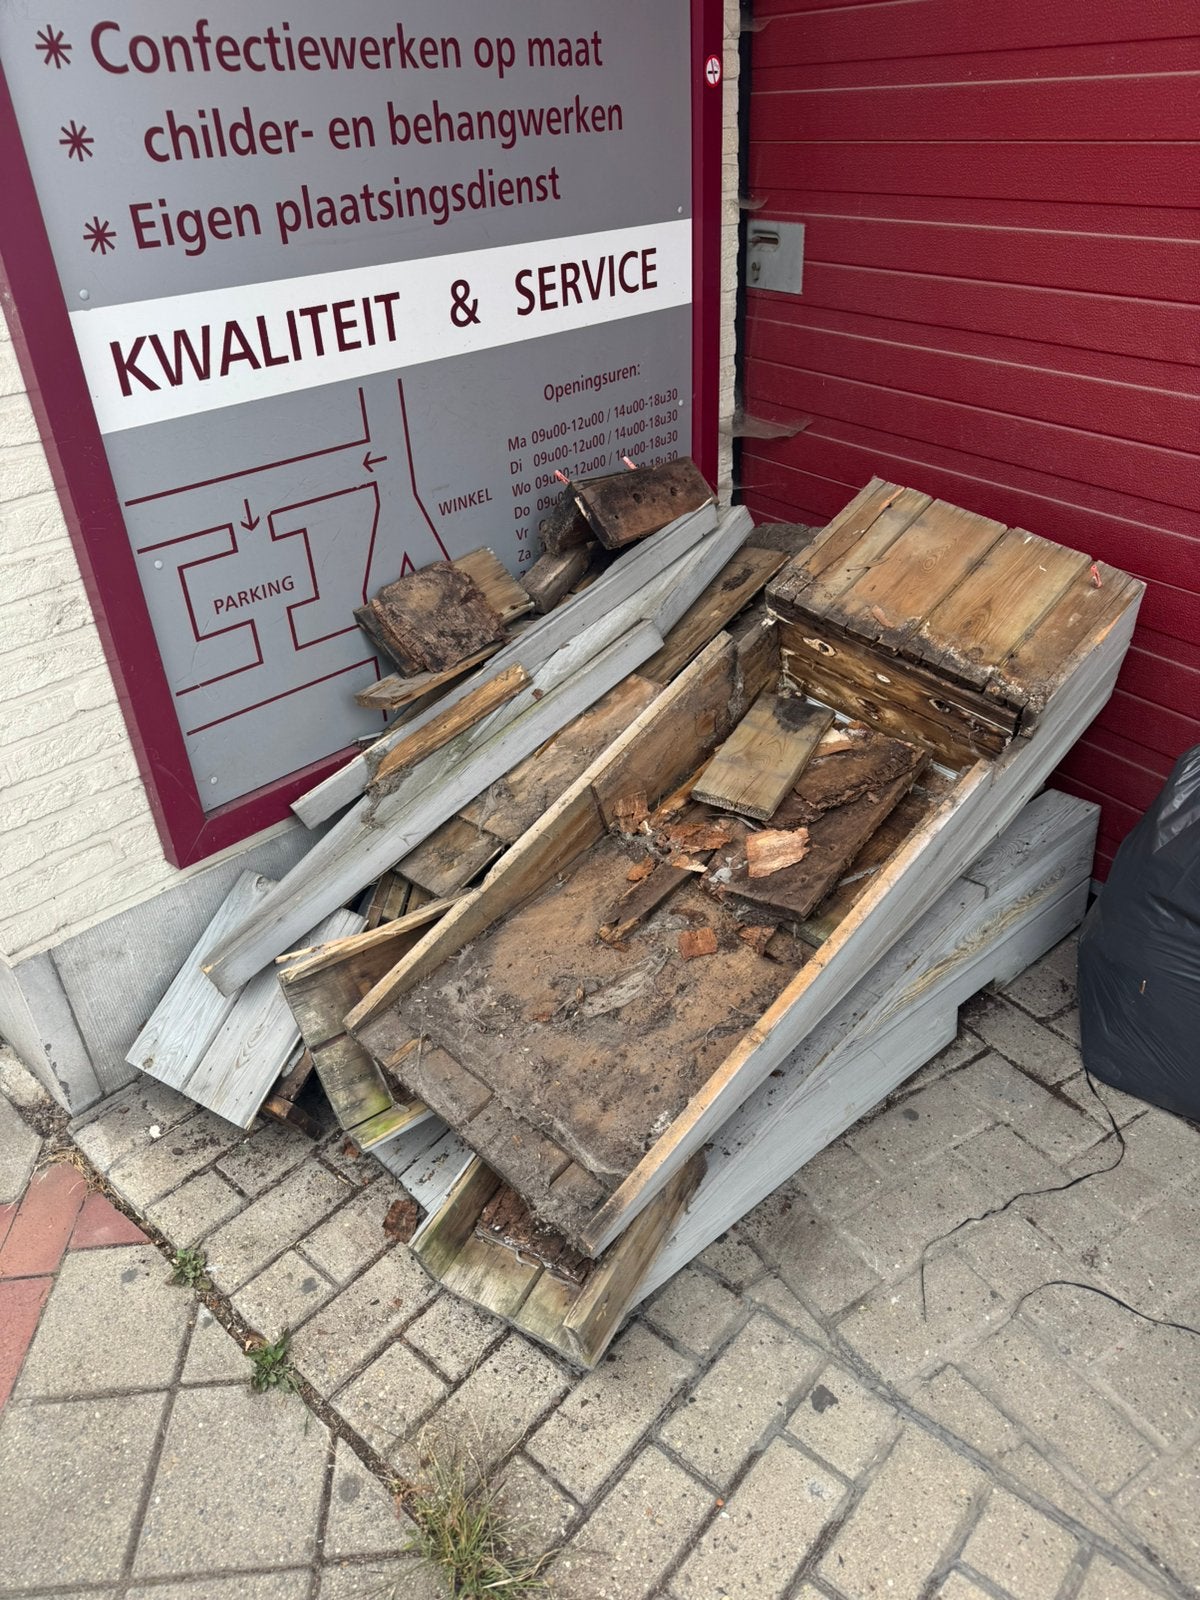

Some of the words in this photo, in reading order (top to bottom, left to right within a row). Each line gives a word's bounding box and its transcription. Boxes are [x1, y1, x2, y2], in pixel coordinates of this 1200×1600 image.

[91, 18, 462, 75] Confectiewerken
[473, 37, 516, 79] op
[527, 30, 603, 68] maat
[328, 116, 376, 150] en
[386, 95, 623, 150] behangwerken
[129, 198, 262, 256] Eigen
[276, 167, 562, 244] plaatsingsdienst
[110, 292, 401, 397] KWALITEIT
[450, 279, 480, 328] &
[515, 248, 659, 316] SERVICE
[543, 363, 641, 402] Openingsuren:
[507, 435, 527, 452] Ma
[531, 411, 605, 445] 09u00-12u00
[614, 388, 678, 419] 14u00-18u30
[510, 458, 523, 475] Di
[533, 432, 605, 467] 09u00-12u00
[615, 409, 678, 441] 14u00-18u30
[438, 487, 493, 516] WINKEL
[511, 481, 532, 497] Wo
[514, 506, 531, 519] Do
[515, 527, 529, 541] Vr
[517, 549, 532, 563] Za
[213, 575, 294, 615] PARKING
